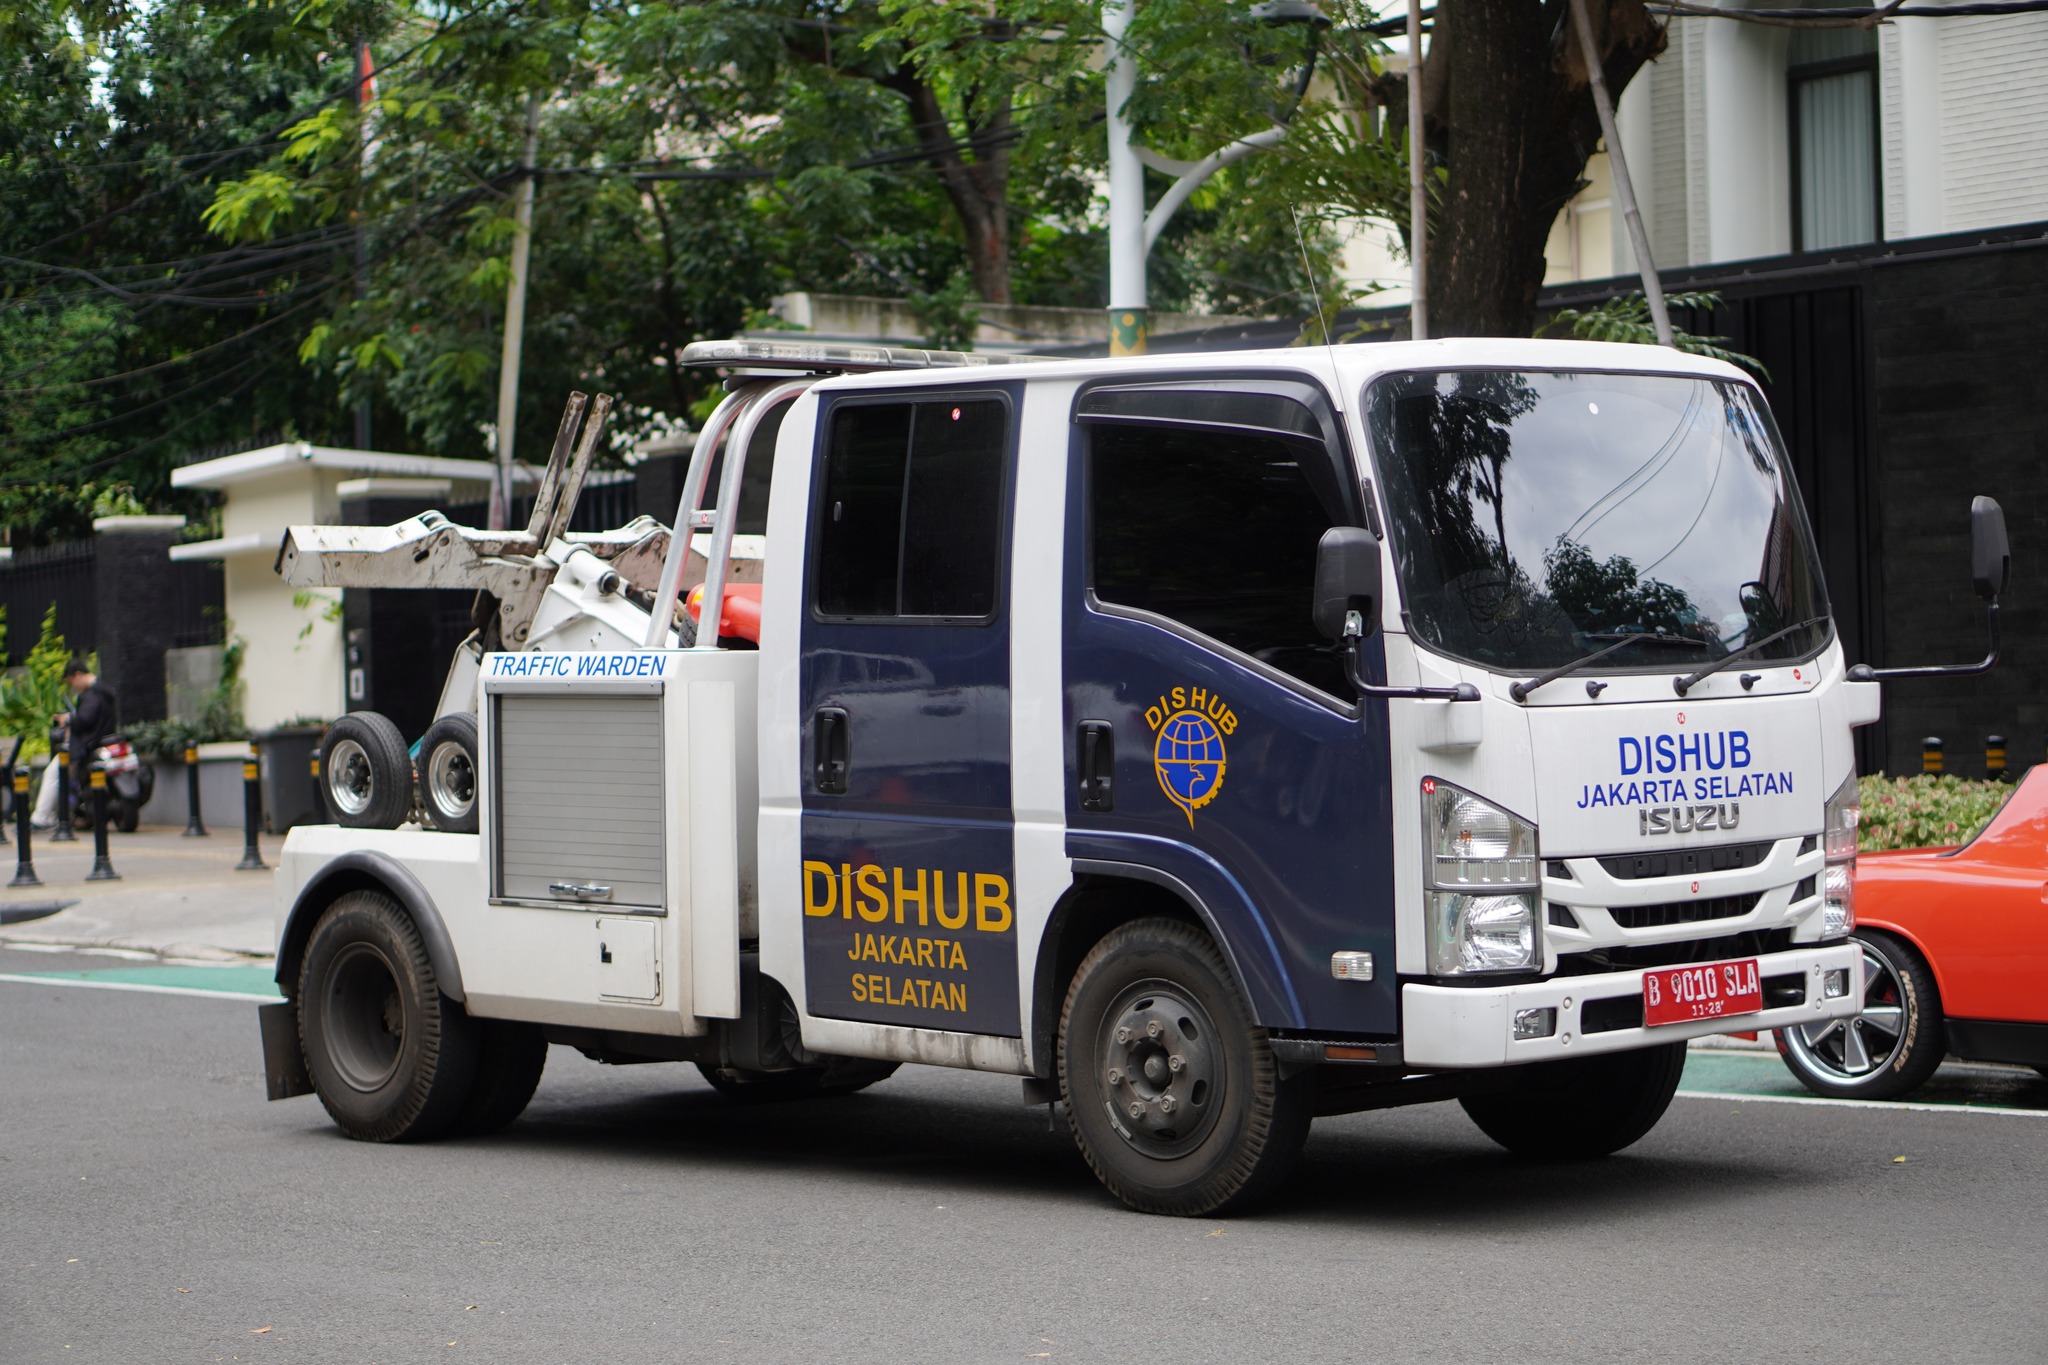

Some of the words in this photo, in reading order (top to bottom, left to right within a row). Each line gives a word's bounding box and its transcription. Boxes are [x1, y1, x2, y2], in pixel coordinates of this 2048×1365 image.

[492, 656, 572, 676] TRAFFIC
[577, 655, 667, 676] WARDEN
[1144, 686, 1239, 736] DISHUB
[1618, 730, 1751, 776] DISHUB
[1577, 779, 1688, 808] JAKARTA
[1694, 771, 1793, 800] SELATAN
[1639, 800, 1740, 836] ISUZU
[803, 860, 1013, 933] DISHUB
[848, 932, 968, 971] JAKARTA
[852, 973, 967, 1012] SELATAN
[1648, 975, 1660, 1007] B
[1670, 967, 1718, 1004] 9010
[1723, 963, 1758, 997] SLA
